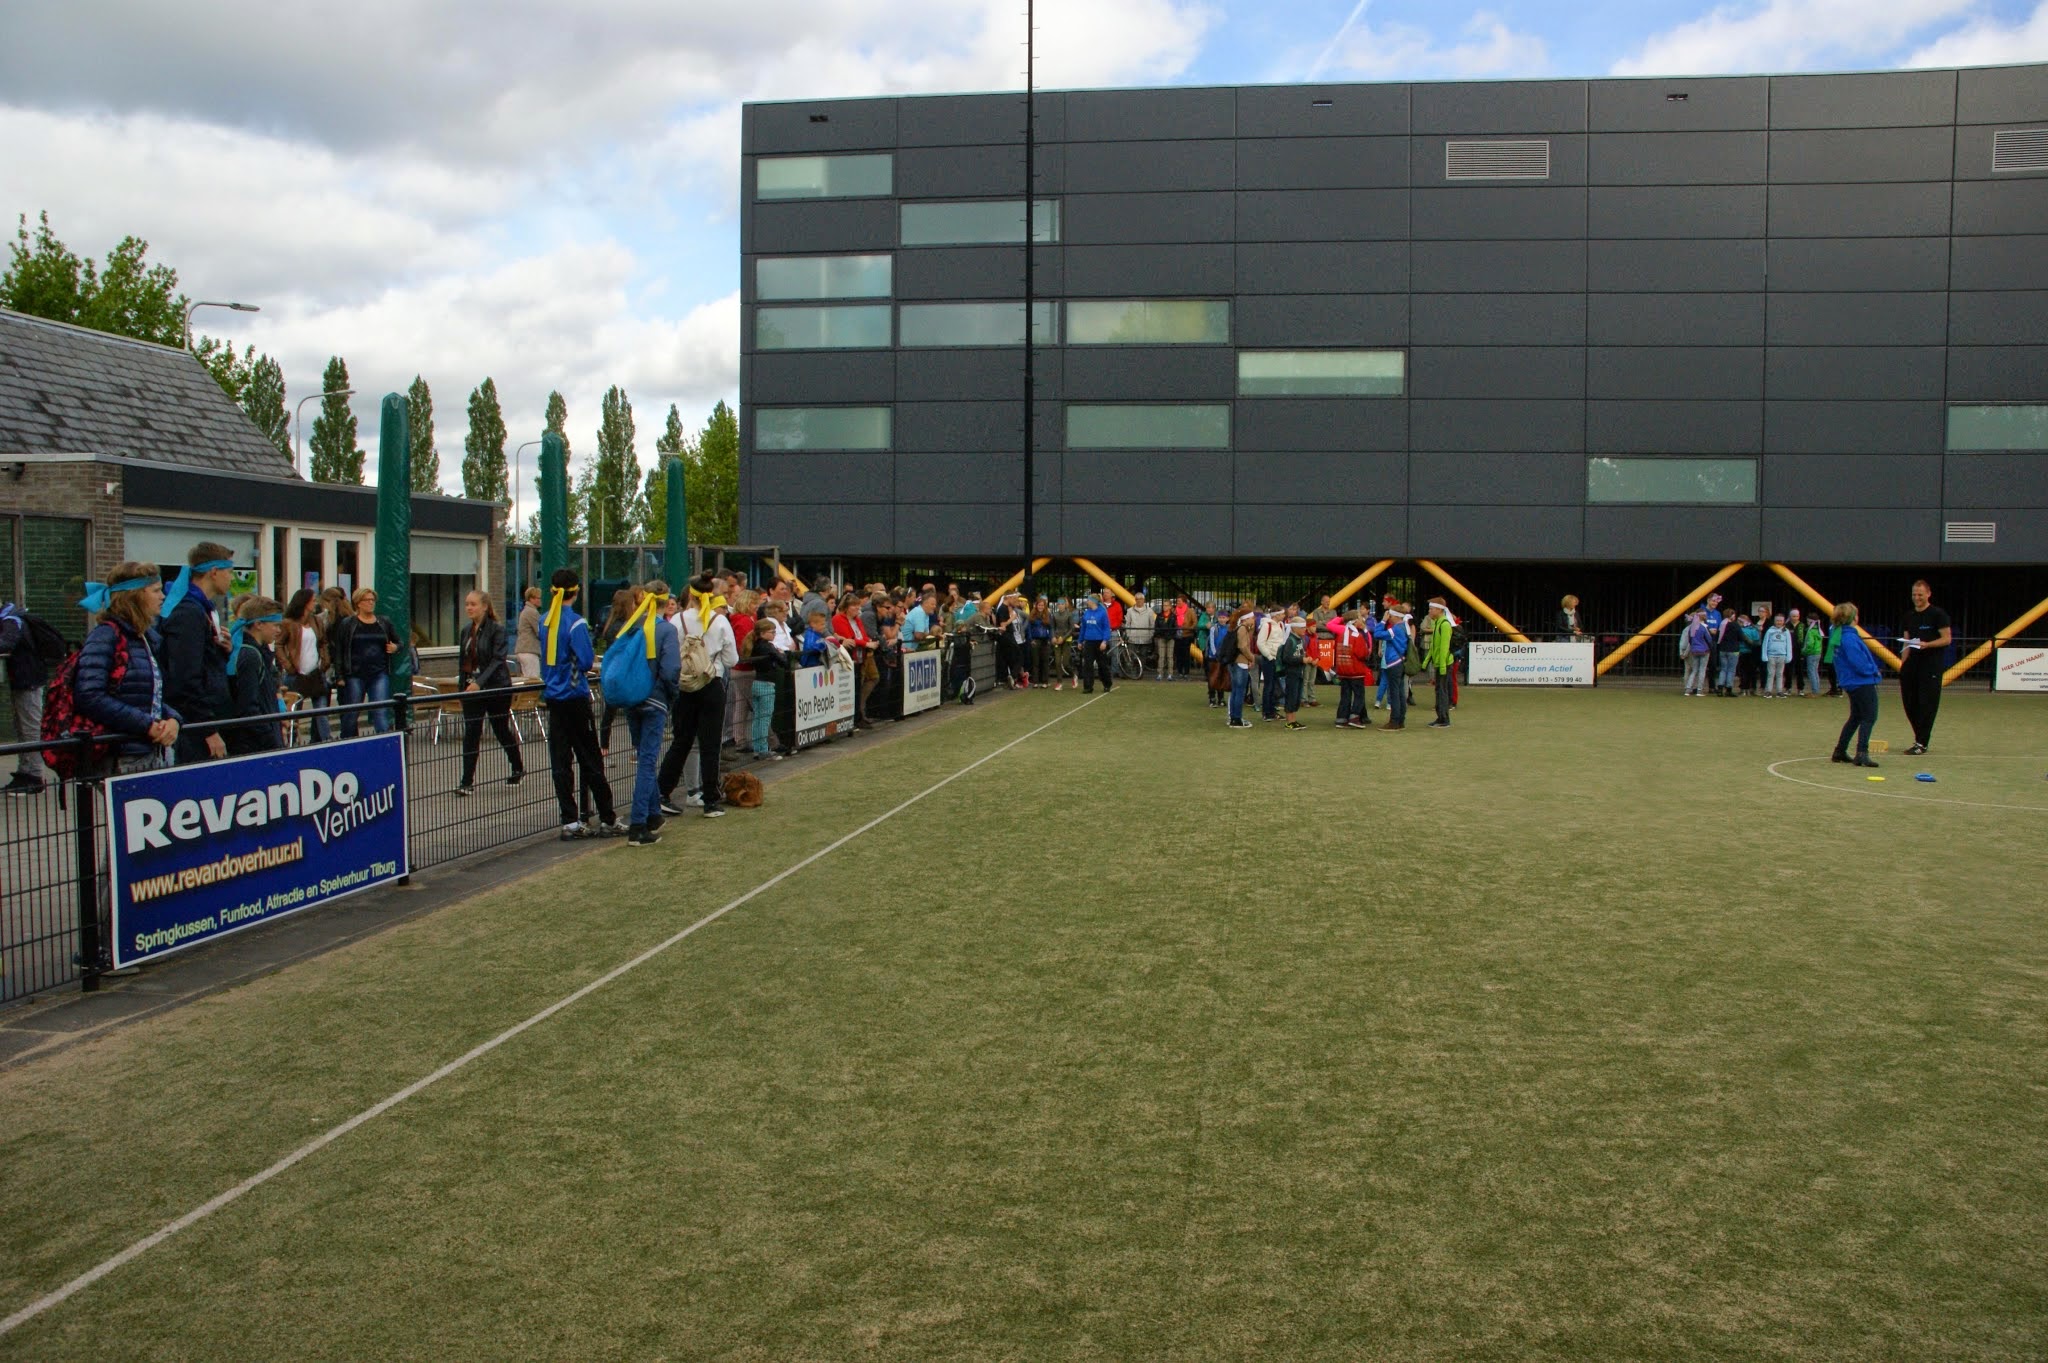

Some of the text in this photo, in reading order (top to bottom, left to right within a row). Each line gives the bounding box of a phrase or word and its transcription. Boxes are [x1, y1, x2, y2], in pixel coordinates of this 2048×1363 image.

[1475, 644, 1537, 656] FysioDalem
[1504, 664, 1536, 673] Gezond
[1548, 664, 1573, 673] Actief
[2015, 660, 2025, 668] UW
[910, 663, 937, 688] DATA
[1478, 676, 1535, 684] www.fysiodalem.nl
[798, 692, 835, 722] Sign People
[797, 730, 809, 746] Ook
[809, 729, 819, 743] voor
[819, 727, 826, 738] uw
[124, 769, 396, 854] RevanDo Verhuur
[130, 836, 303, 903] www.revandoverhuur.nl
[135, 860, 396, 952] Springkussen, Funfood, Attractie en Spelverhuur Tilburg
